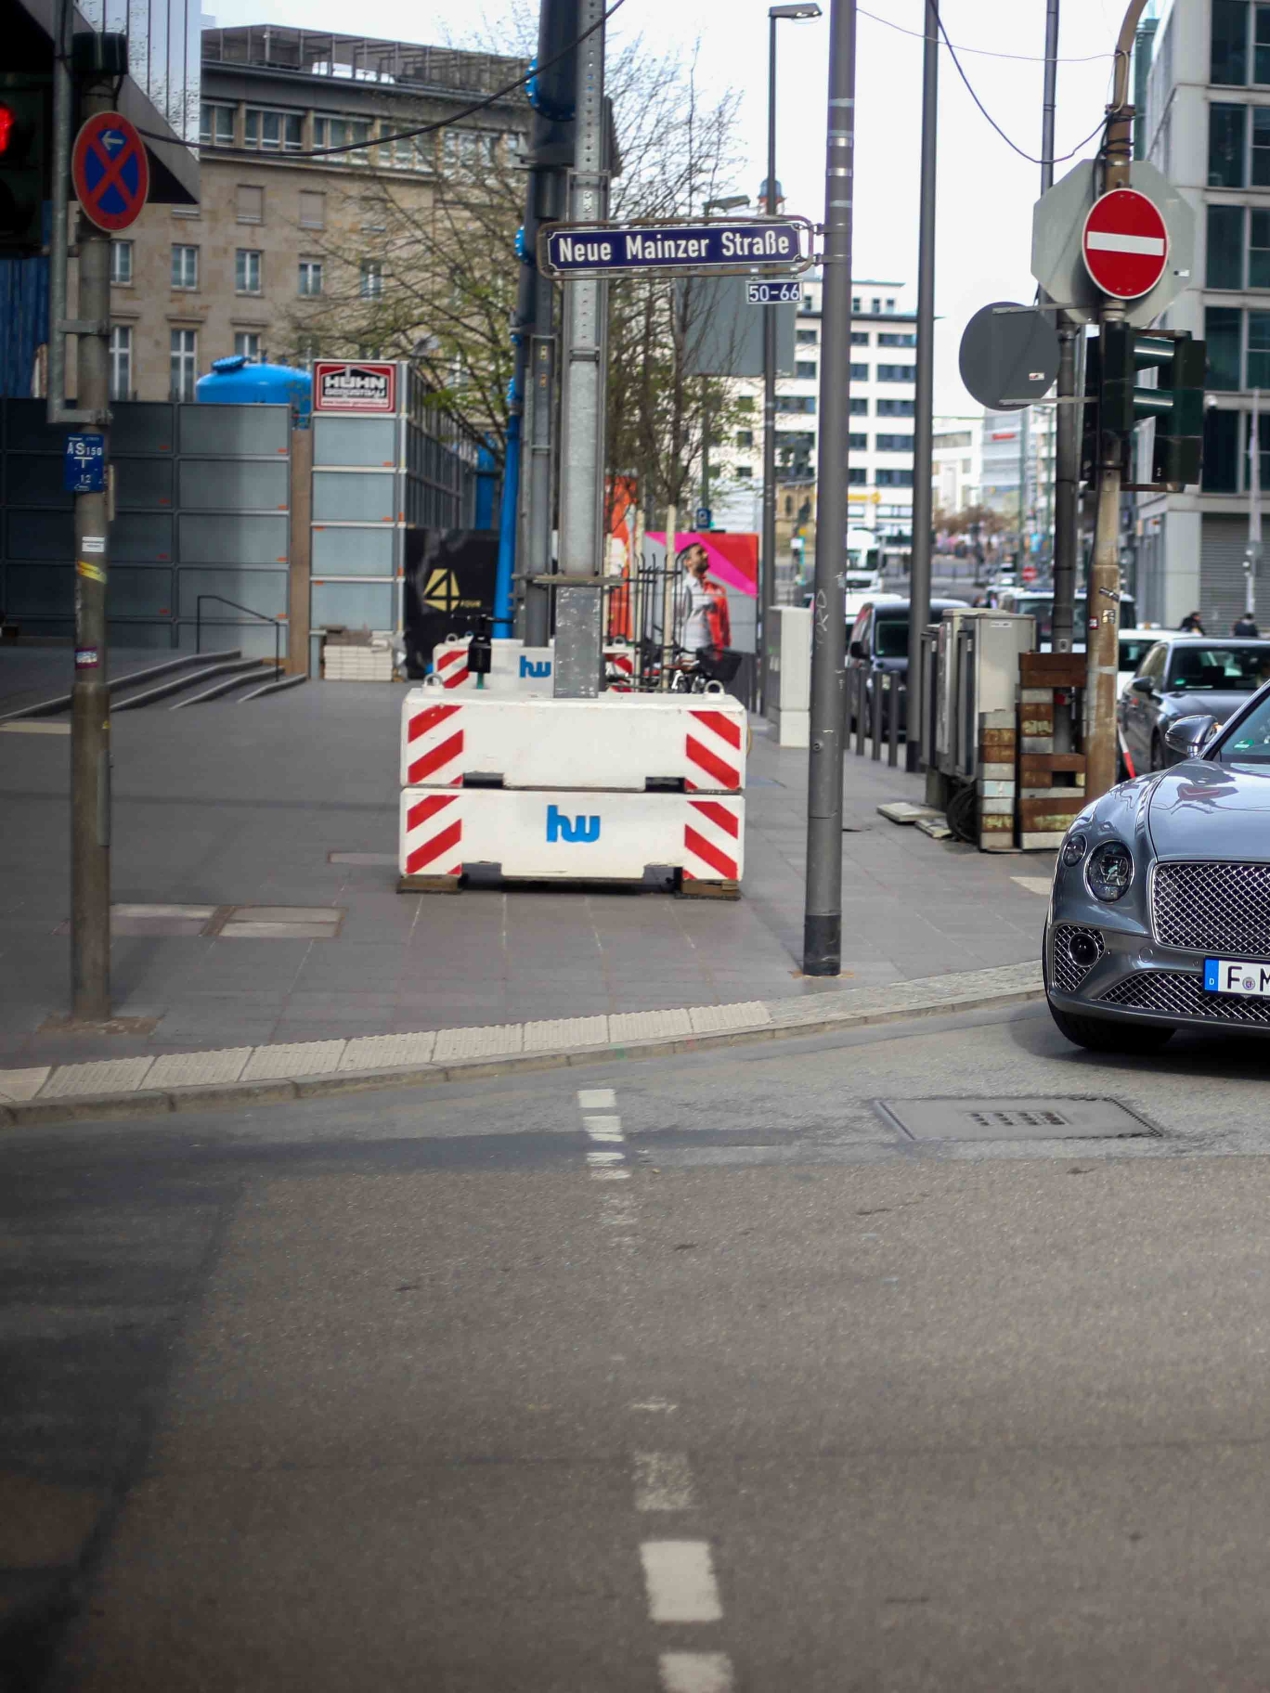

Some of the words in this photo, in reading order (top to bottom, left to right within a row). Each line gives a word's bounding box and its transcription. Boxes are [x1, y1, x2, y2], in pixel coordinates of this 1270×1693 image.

[558, 237, 612, 262] Neue
[625, 233, 710, 260] Mainzer
[721, 230, 790, 257] Straße
[749, 284, 800, 302] 50-66
[519, 655, 552, 678] hw
[546, 804, 601, 843] hw
[1227, 965, 1243, 989] F
